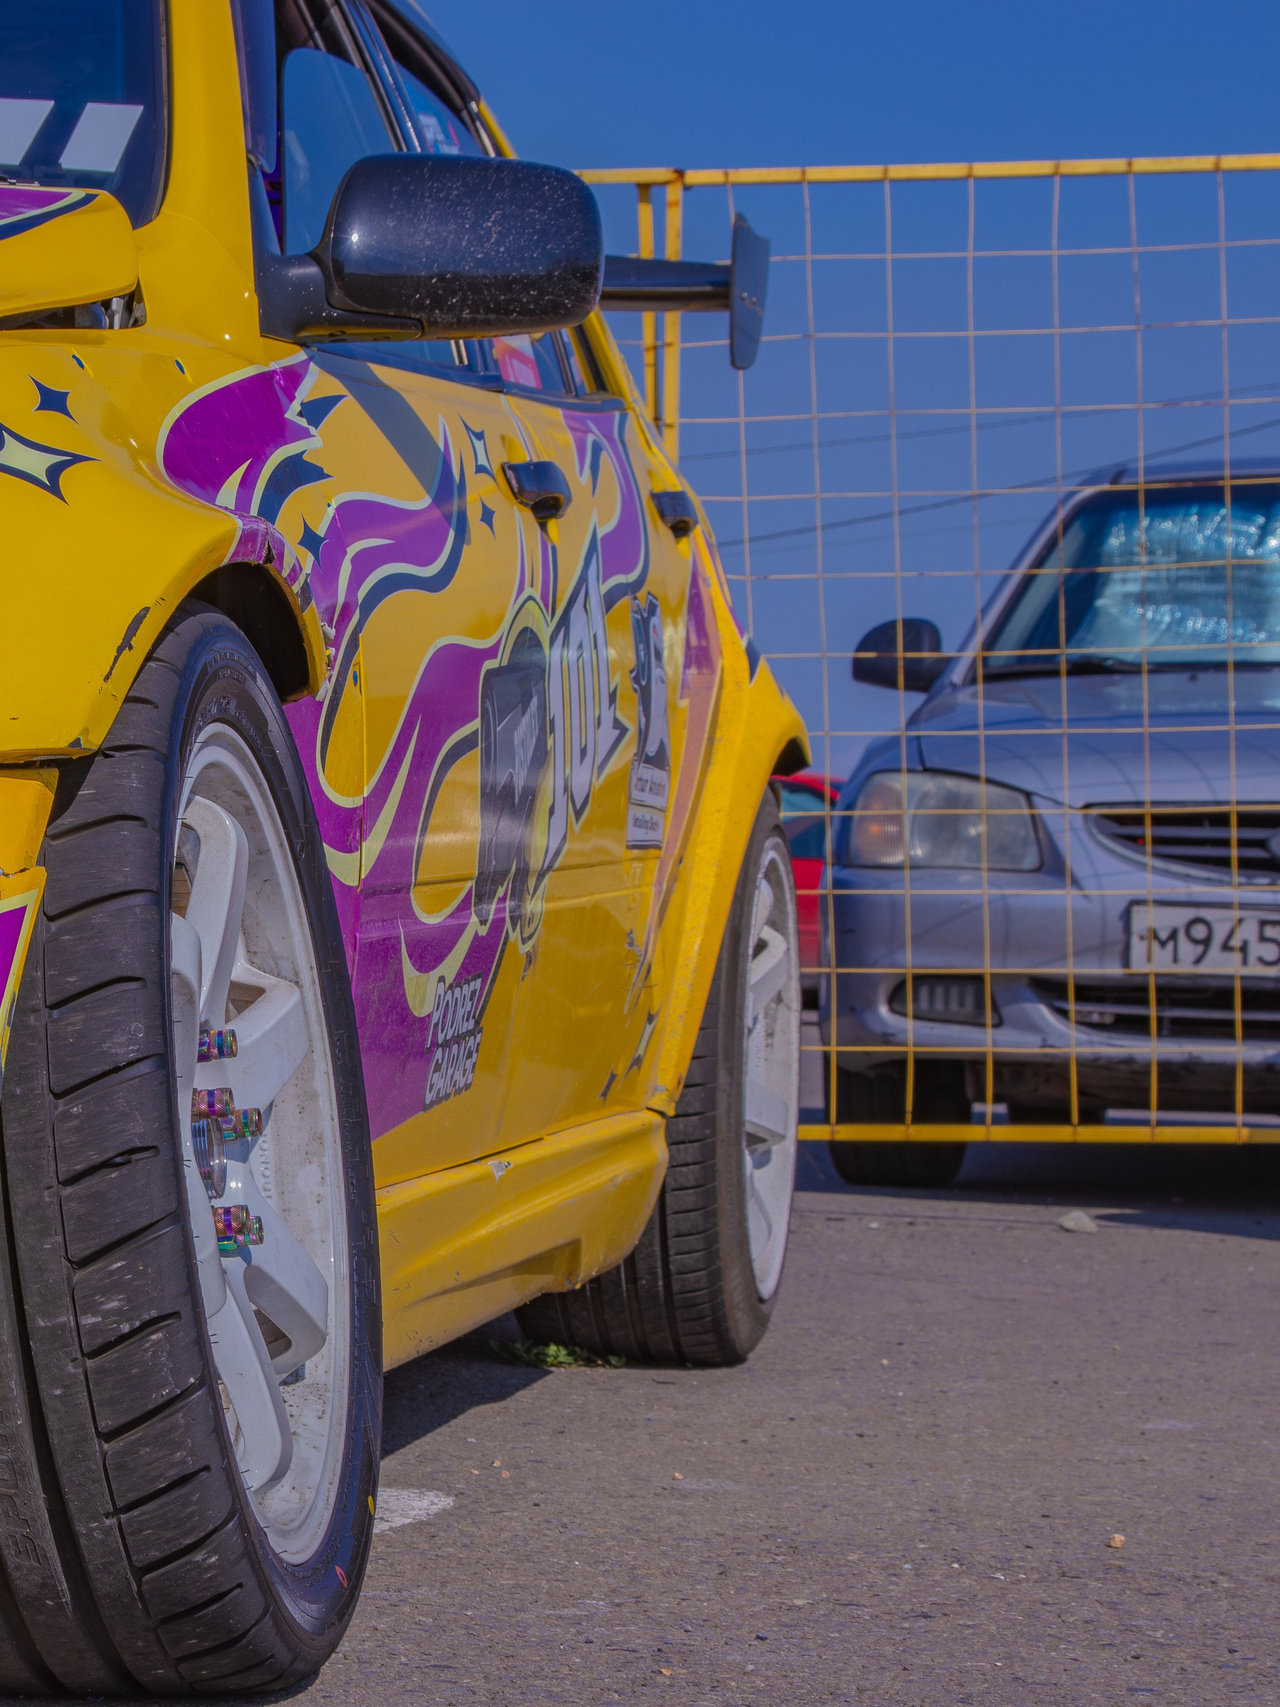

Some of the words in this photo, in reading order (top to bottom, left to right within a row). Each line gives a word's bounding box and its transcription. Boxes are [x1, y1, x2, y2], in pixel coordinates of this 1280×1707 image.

[543, 552, 620, 870] 101
[425, 979, 483, 1049] PODREZ
[425, 1031, 483, 1105] GARAGE
